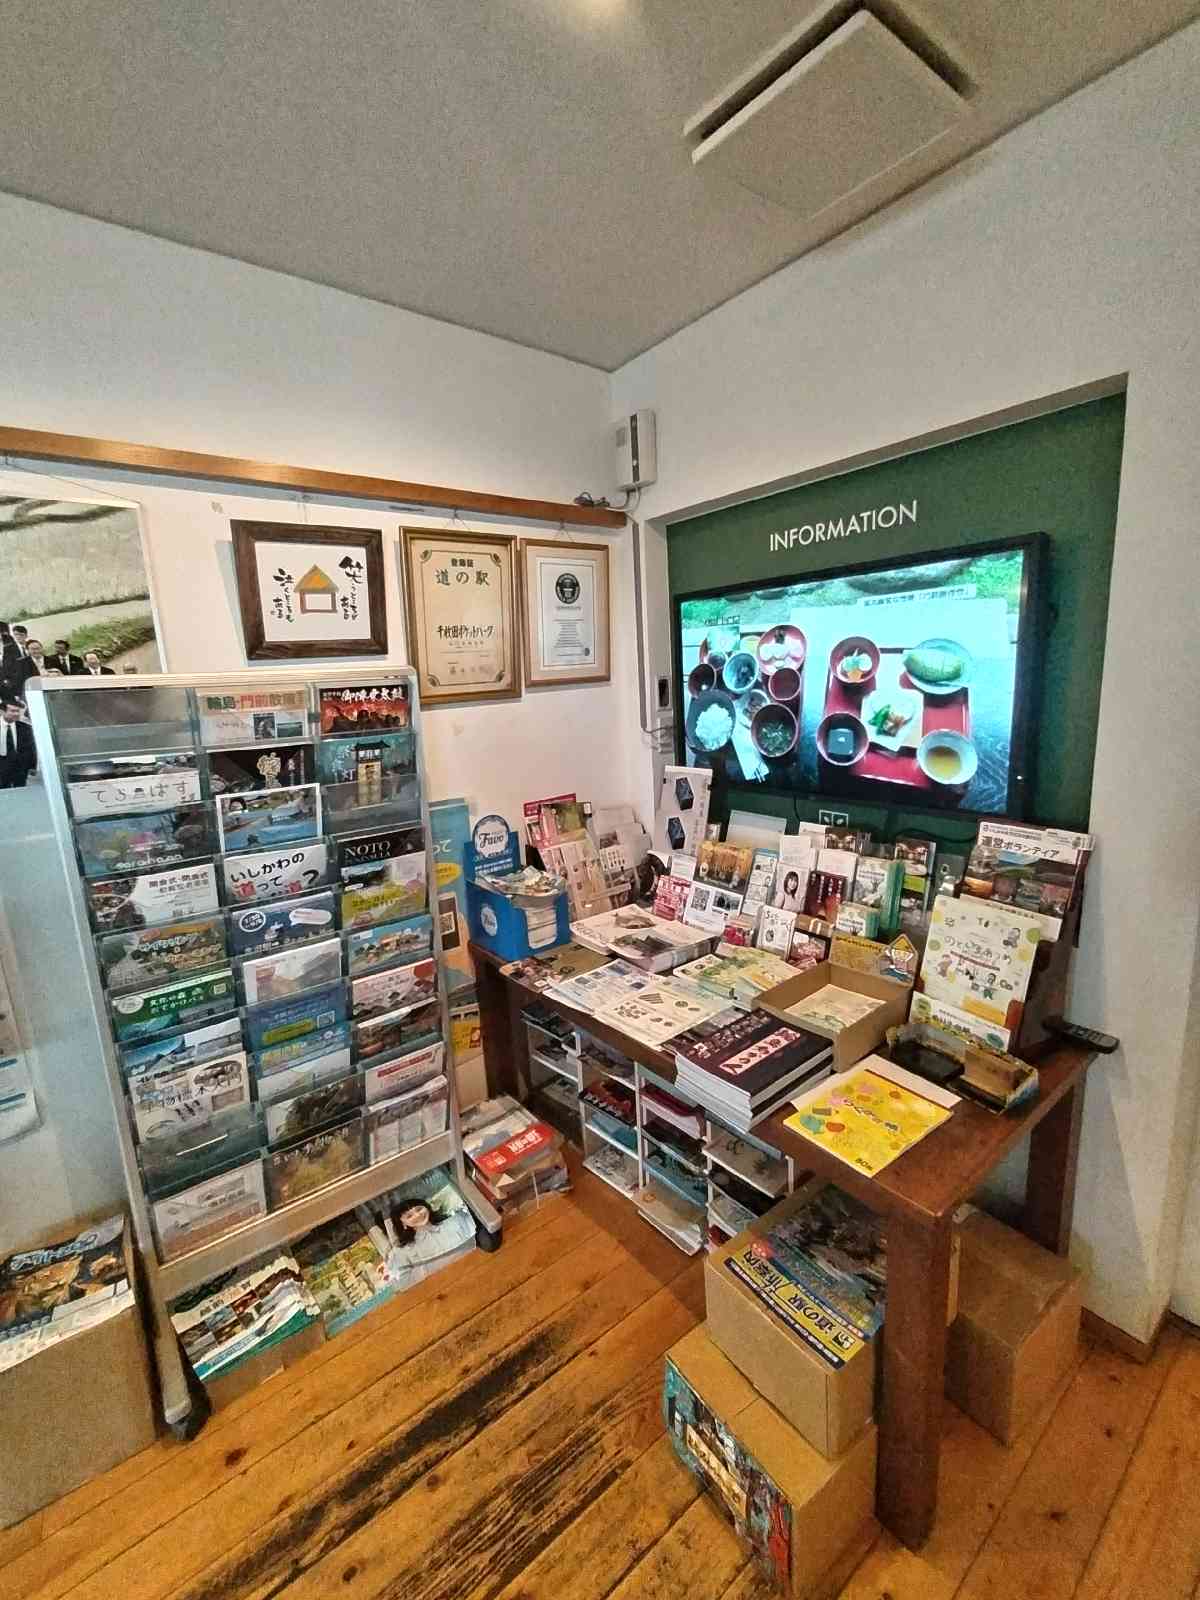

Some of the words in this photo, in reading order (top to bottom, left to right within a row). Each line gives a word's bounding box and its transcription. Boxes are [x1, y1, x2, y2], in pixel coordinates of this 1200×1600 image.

[769, 500, 918, 552] INFORMATION
[436, 569, 490, 586] 道の駅
[345, 841, 392, 858] NOTO
[231, 852, 305, 882] いしかわの
